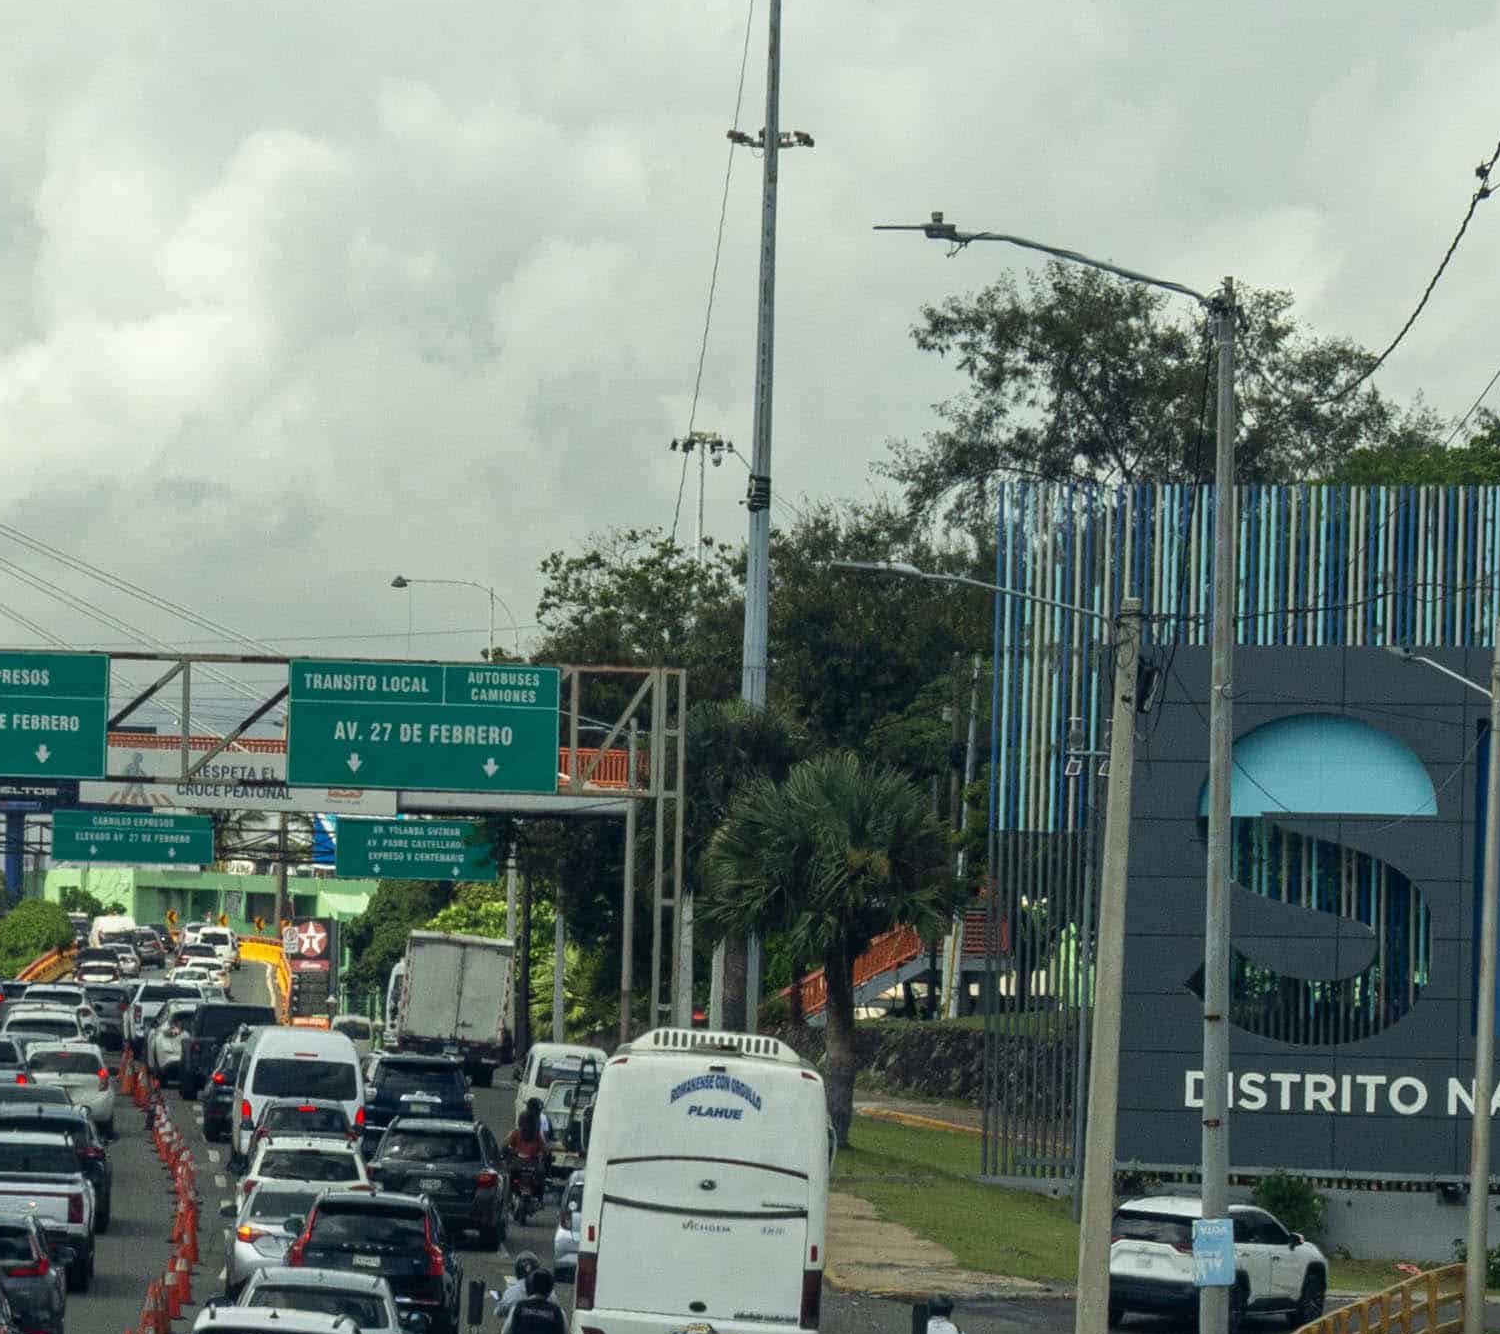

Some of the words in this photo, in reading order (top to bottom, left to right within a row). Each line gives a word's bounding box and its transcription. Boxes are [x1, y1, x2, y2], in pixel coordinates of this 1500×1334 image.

[304, 673, 377, 692] TRANSITO
[382, 676, 430, 693] LOCAL
[468, 671, 540, 687] AUTOBUSES
[471, 689, 537, 703] CAMIONES
[12, 714, 80, 732] FEBRERO
[334, 721, 364, 741] AV.
[370, 723, 393, 742] 27
[400, 724, 423, 743] DE
[429, 726, 513, 746] FEBRERO
[176, 782, 221, 797] CRUCE
[225, 784, 294, 800] PEATONAL
[1184, 1070, 1428, 1114] DISTRITO
[688, 1105, 744, 1120] PLAHUE
